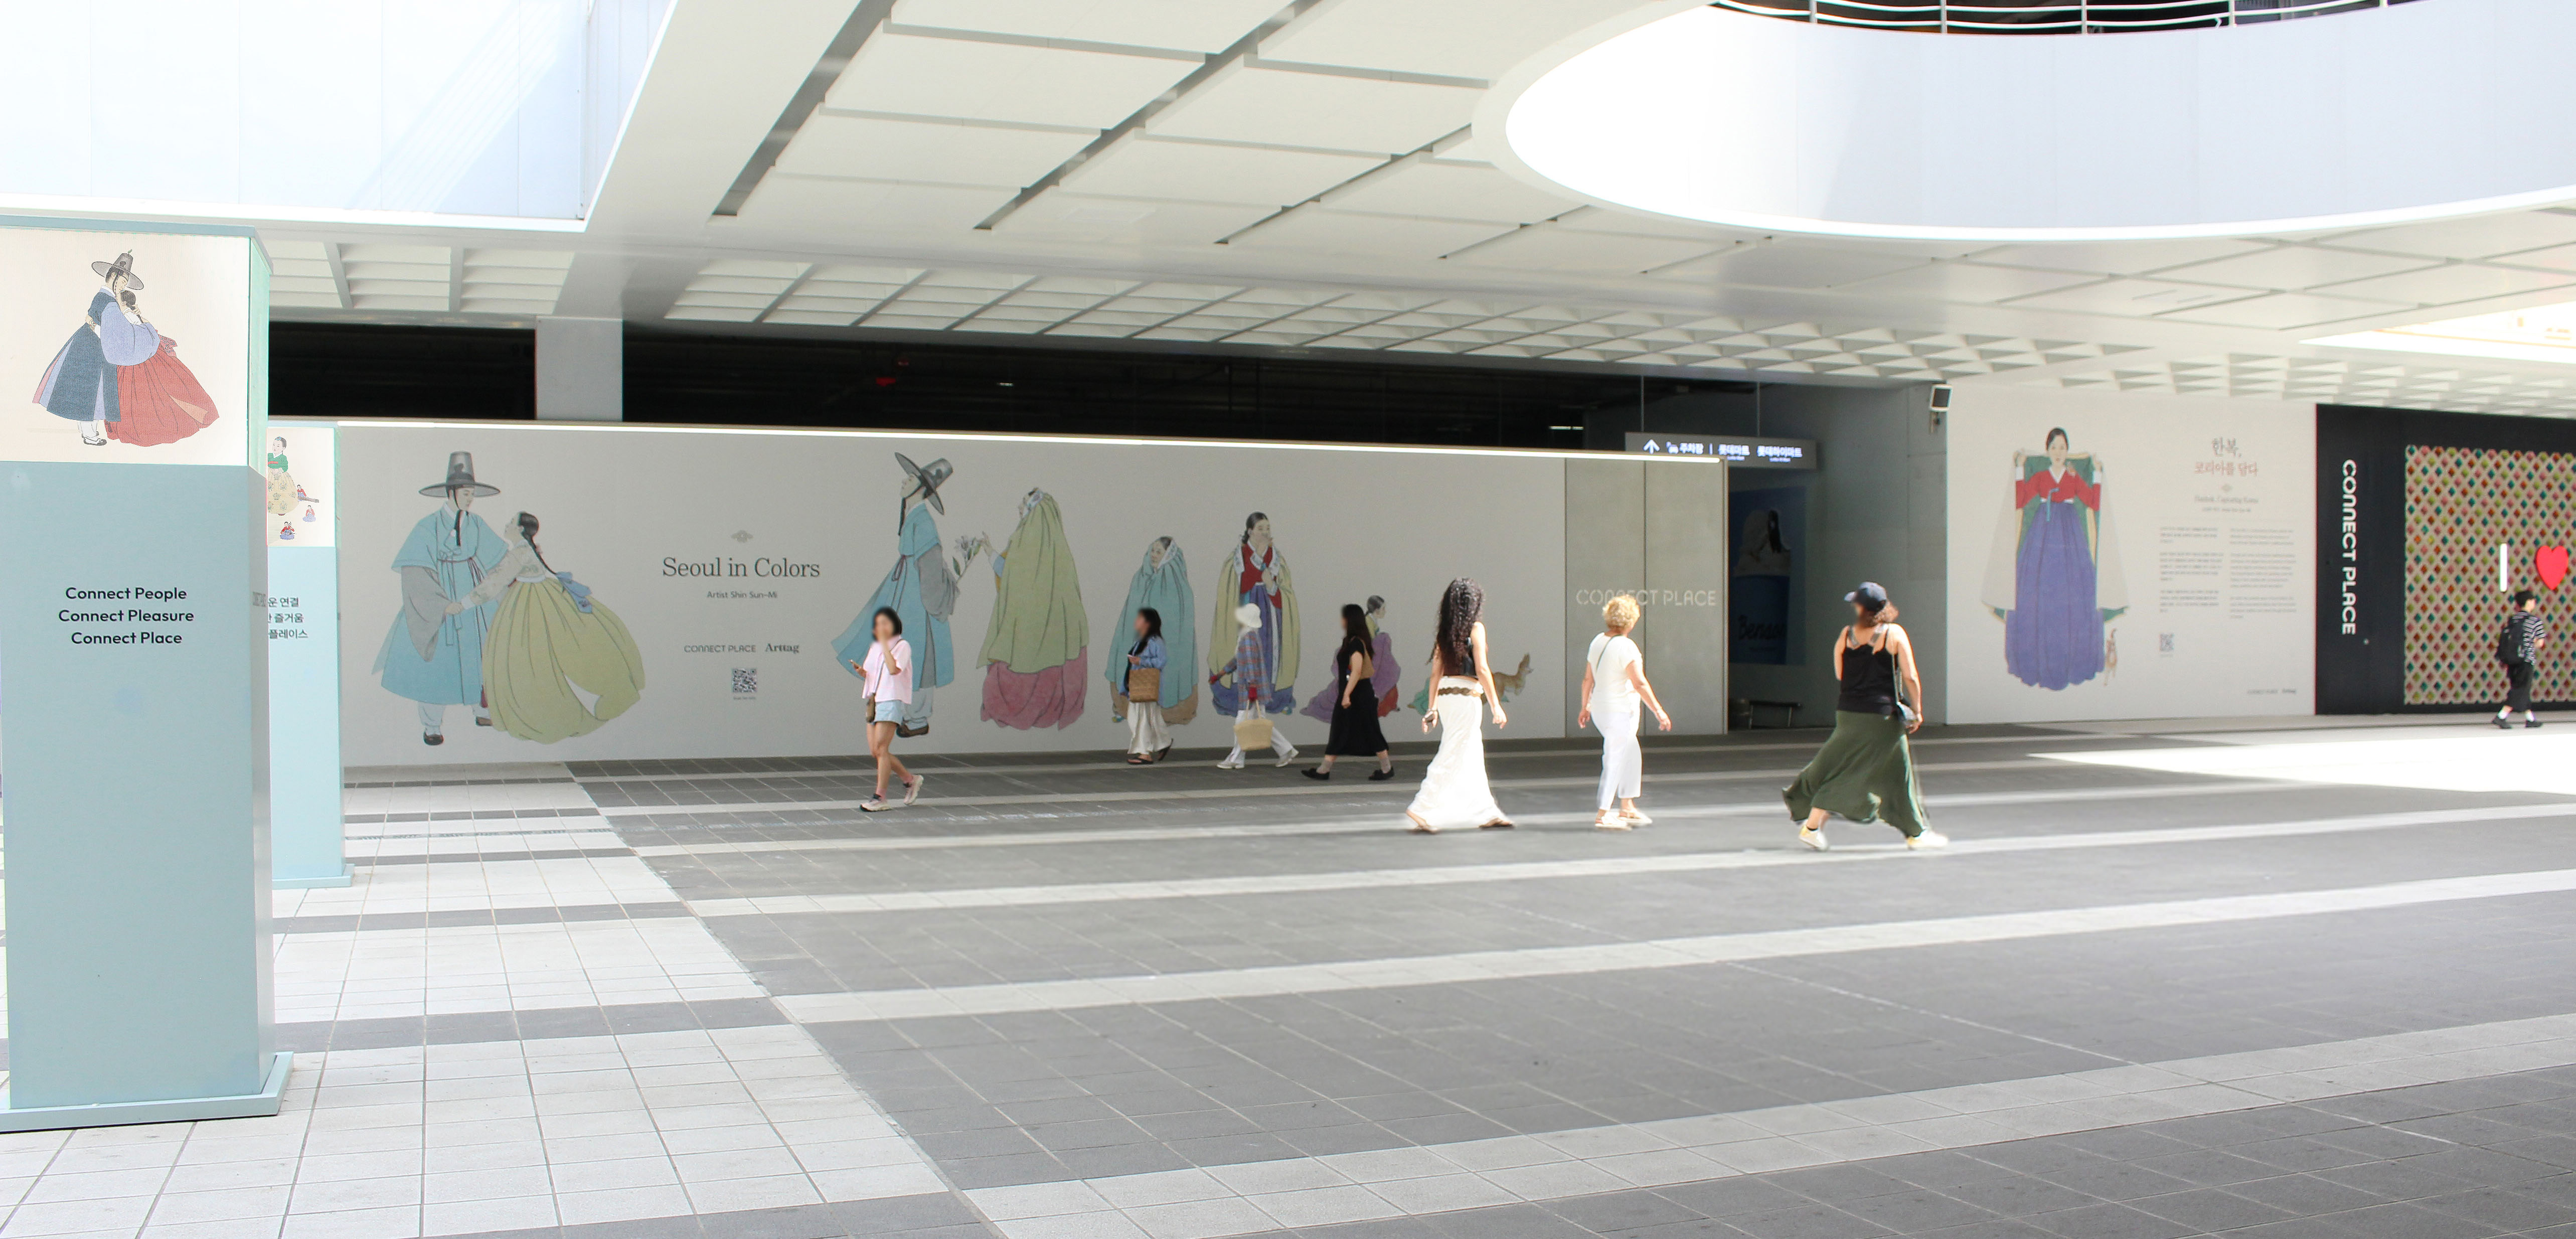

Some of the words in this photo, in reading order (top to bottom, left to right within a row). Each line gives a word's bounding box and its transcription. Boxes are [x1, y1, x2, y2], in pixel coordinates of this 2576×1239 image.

[2342, 459, 2356, 561] CONNECT
[663, 557, 722, 577] Seoul
[728, 557, 747, 577] in
[754, 557, 820, 577] Colors
[65, 587, 131, 599] Connect
[135, 587, 187, 603] People
[279, 596, 299, 607] 연결
[1576, 589, 1658, 605] CONCT
[1663, 590, 1718, 606] PLACE
[2342, 567, 2356, 635] PLACE
[59, 609, 124, 623] Connect
[128, 609, 195, 623] Pleasure
[274, 612, 304, 623] 즐거움
[71, 632, 136, 645] Connect
[140, 632, 182, 645] Place
[269, 629, 309, 639] 플레이스
[684, 644, 726, 653] CONNECT
[728, 644, 756, 653] PLACE
[765, 643, 799, 654] Arttag
